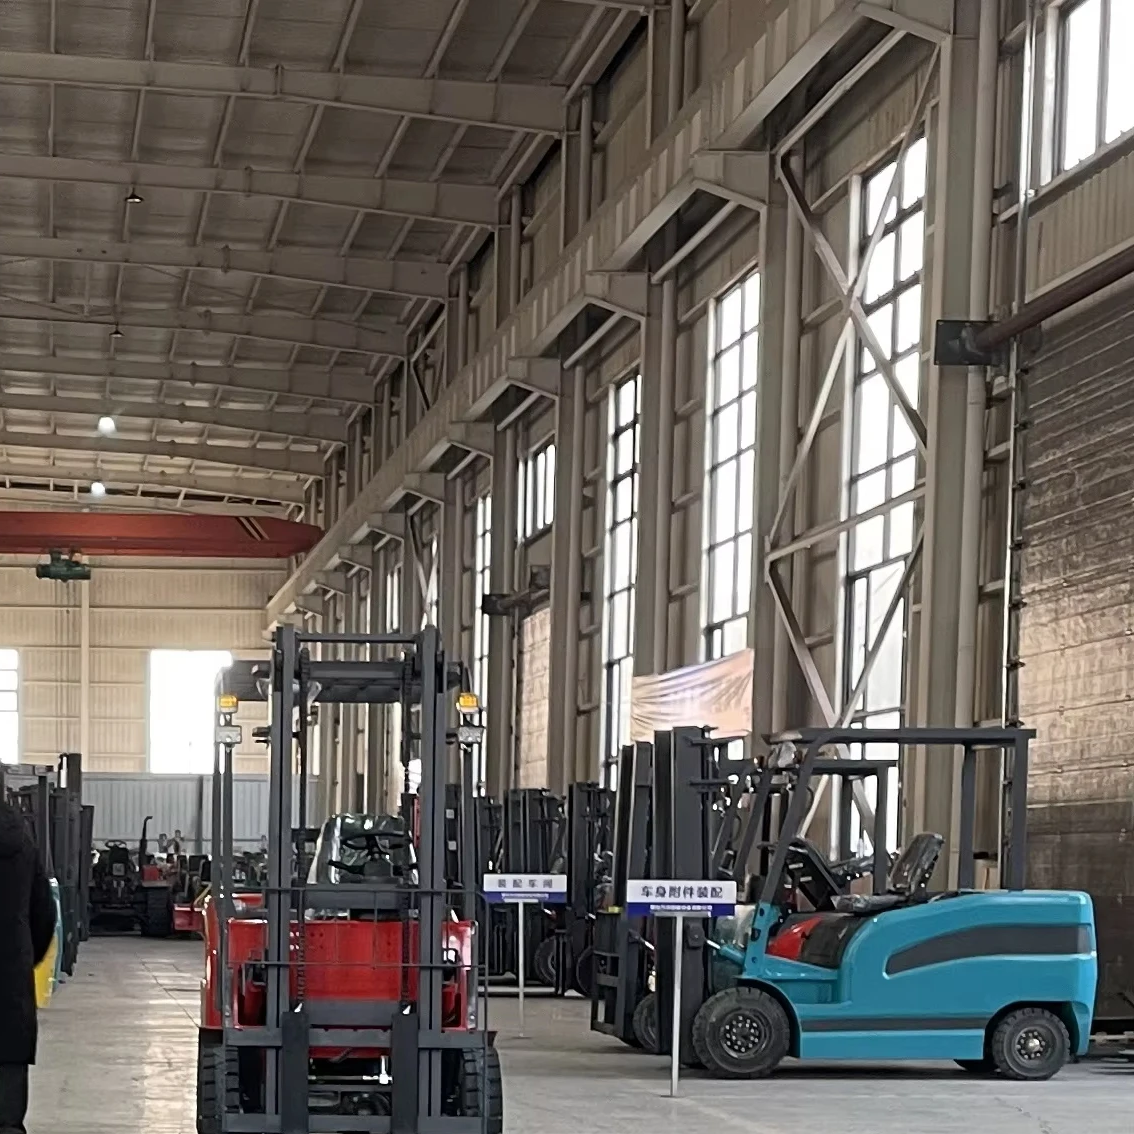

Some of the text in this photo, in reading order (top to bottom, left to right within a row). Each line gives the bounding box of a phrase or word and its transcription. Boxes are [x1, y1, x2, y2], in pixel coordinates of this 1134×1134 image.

[641, 885, 724, 899] 车身附件装配
